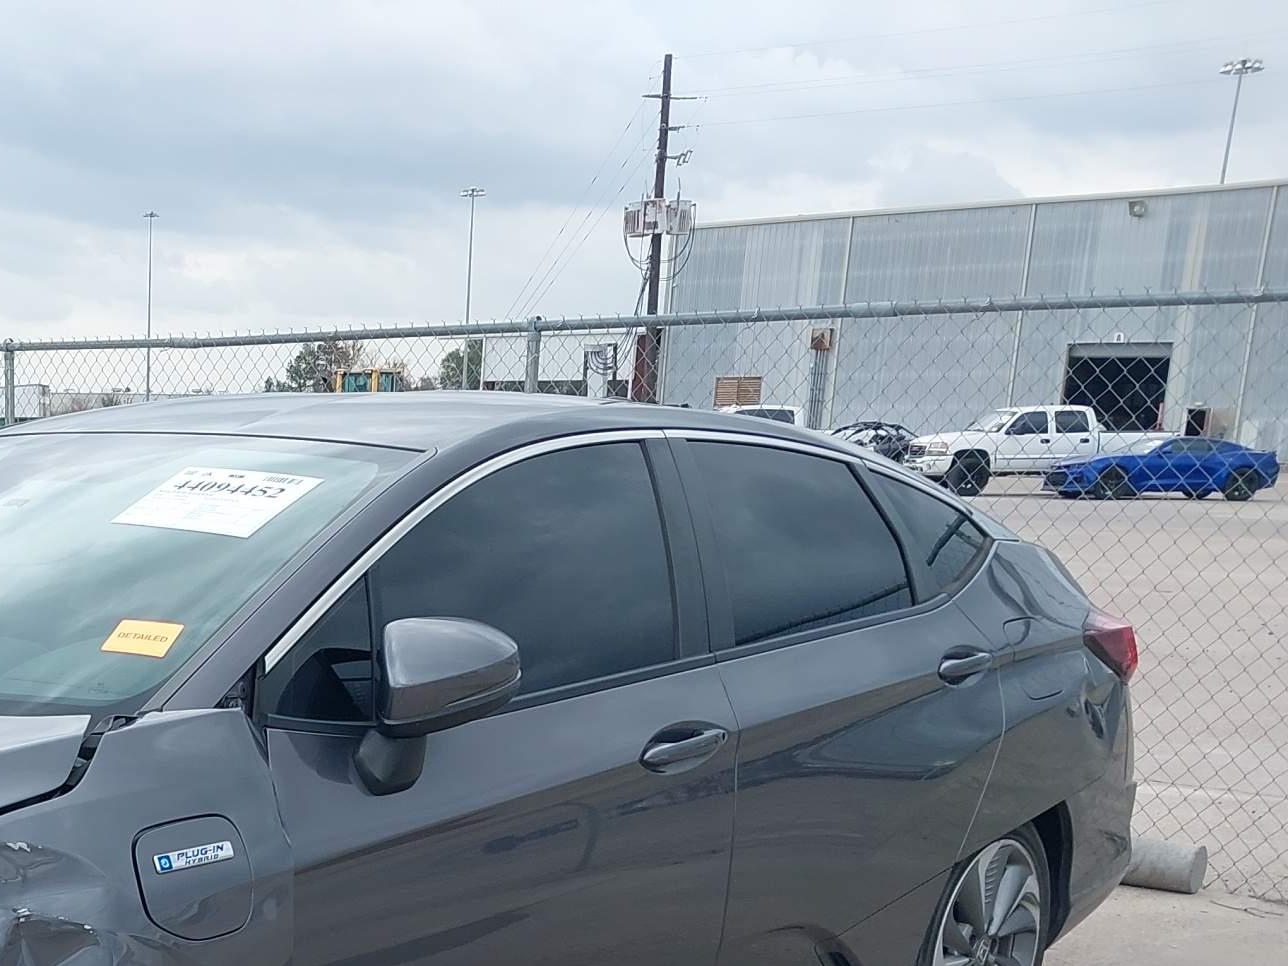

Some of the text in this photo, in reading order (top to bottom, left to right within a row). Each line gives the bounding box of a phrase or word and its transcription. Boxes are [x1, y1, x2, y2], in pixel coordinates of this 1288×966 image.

[173, 479, 286, 499] 44094452
[117, 631, 169, 643] DETAILED
[176, 843, 225, 861] PLUG-IN
[184, 853, 220, 867] HYBRID
